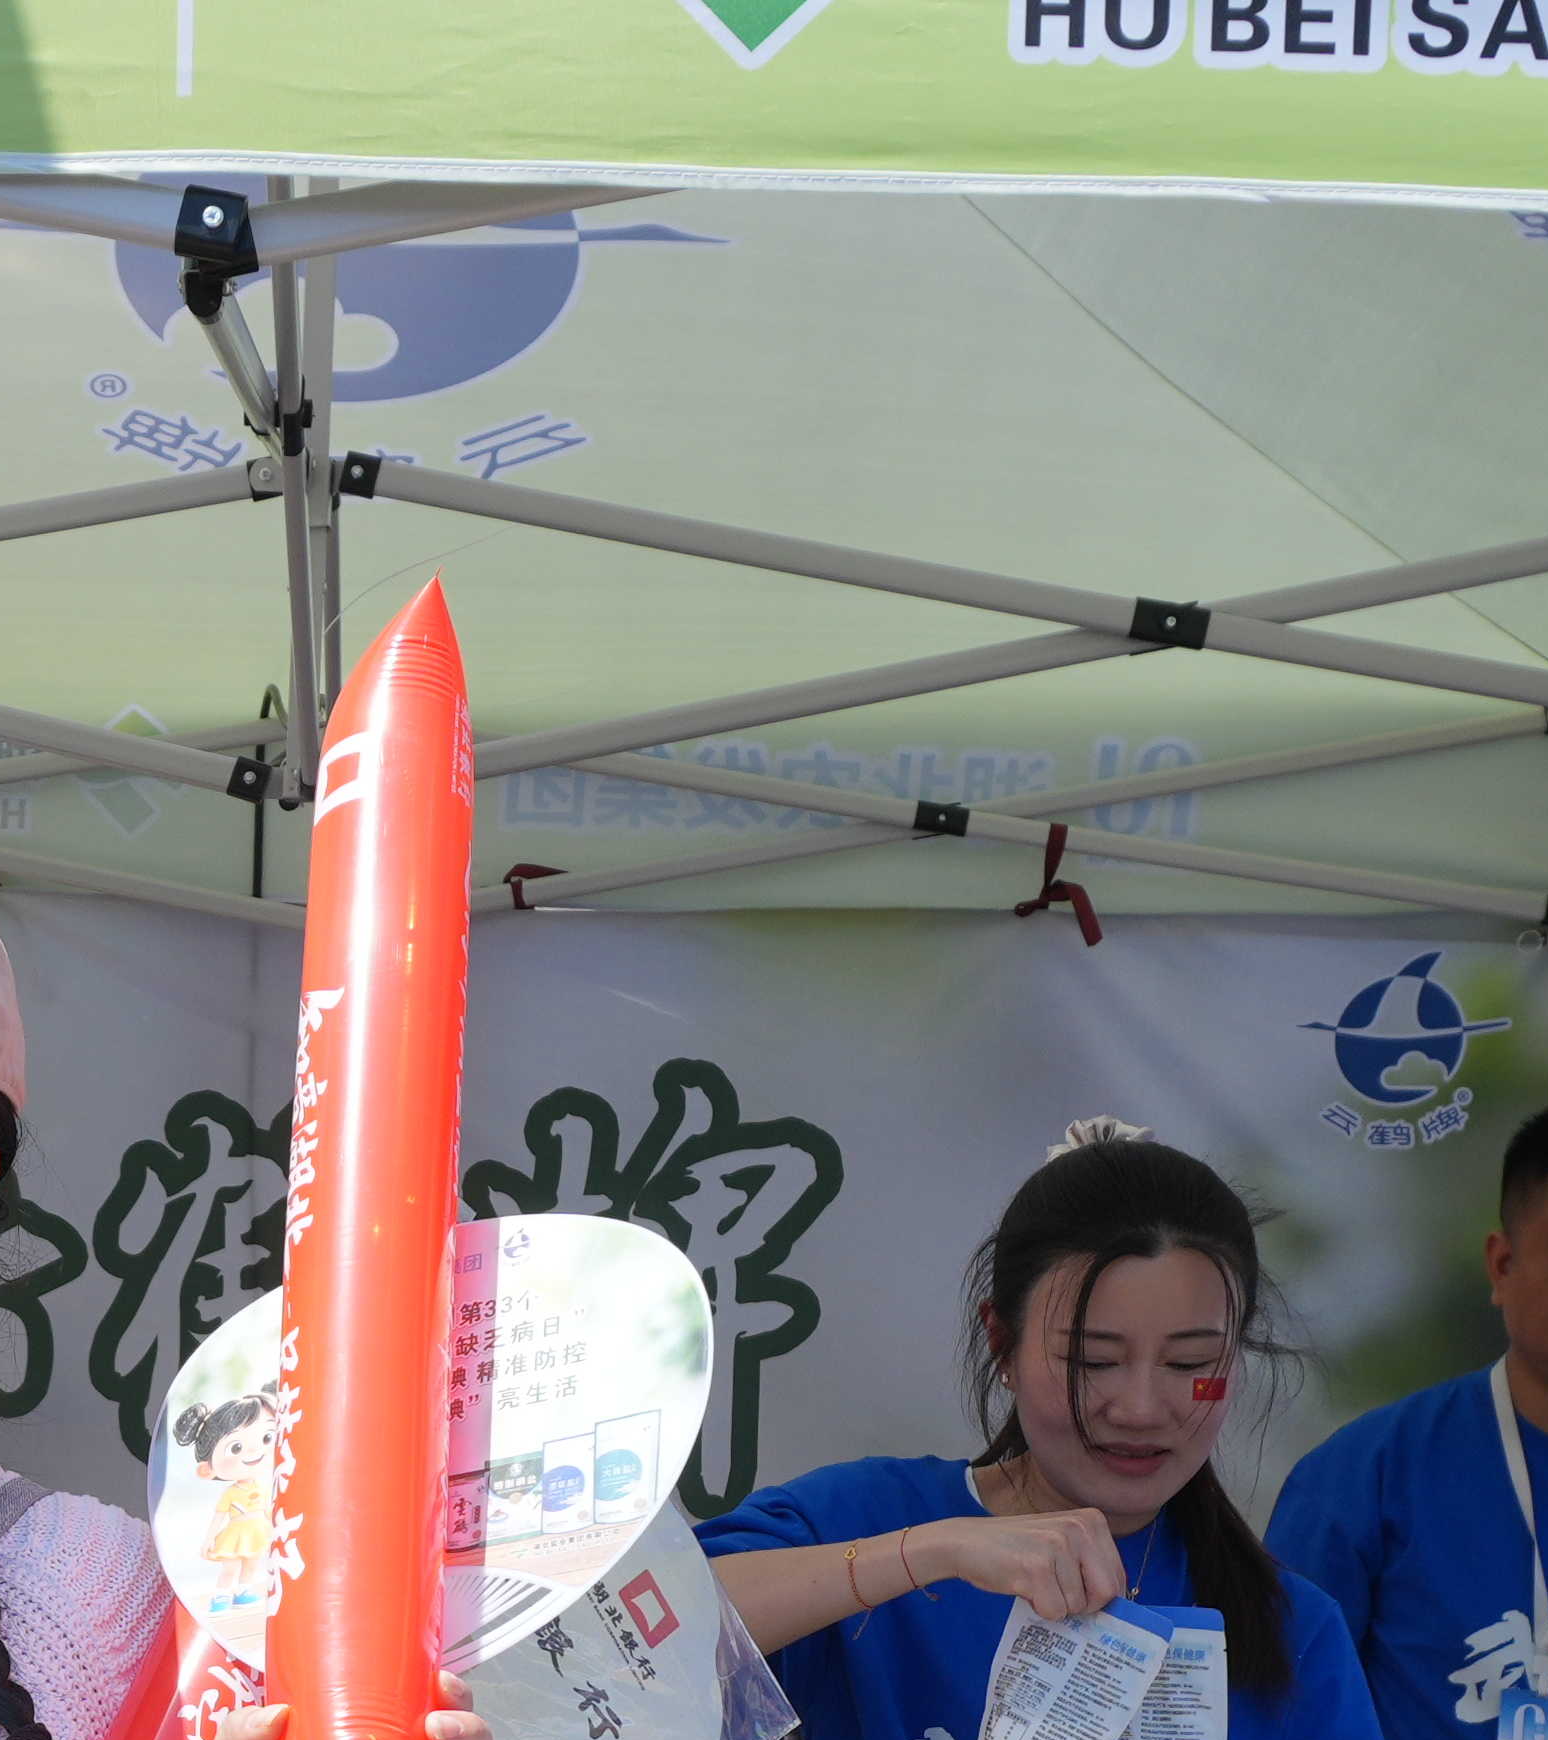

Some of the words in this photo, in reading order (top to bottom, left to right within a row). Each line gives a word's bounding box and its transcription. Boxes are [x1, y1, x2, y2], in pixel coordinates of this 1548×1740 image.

[1026, 0, 1169, 50] HU
[1212, 0, 1371, 55] BEI
[1319, 1097, 1467, 1148] 云鹤牌
